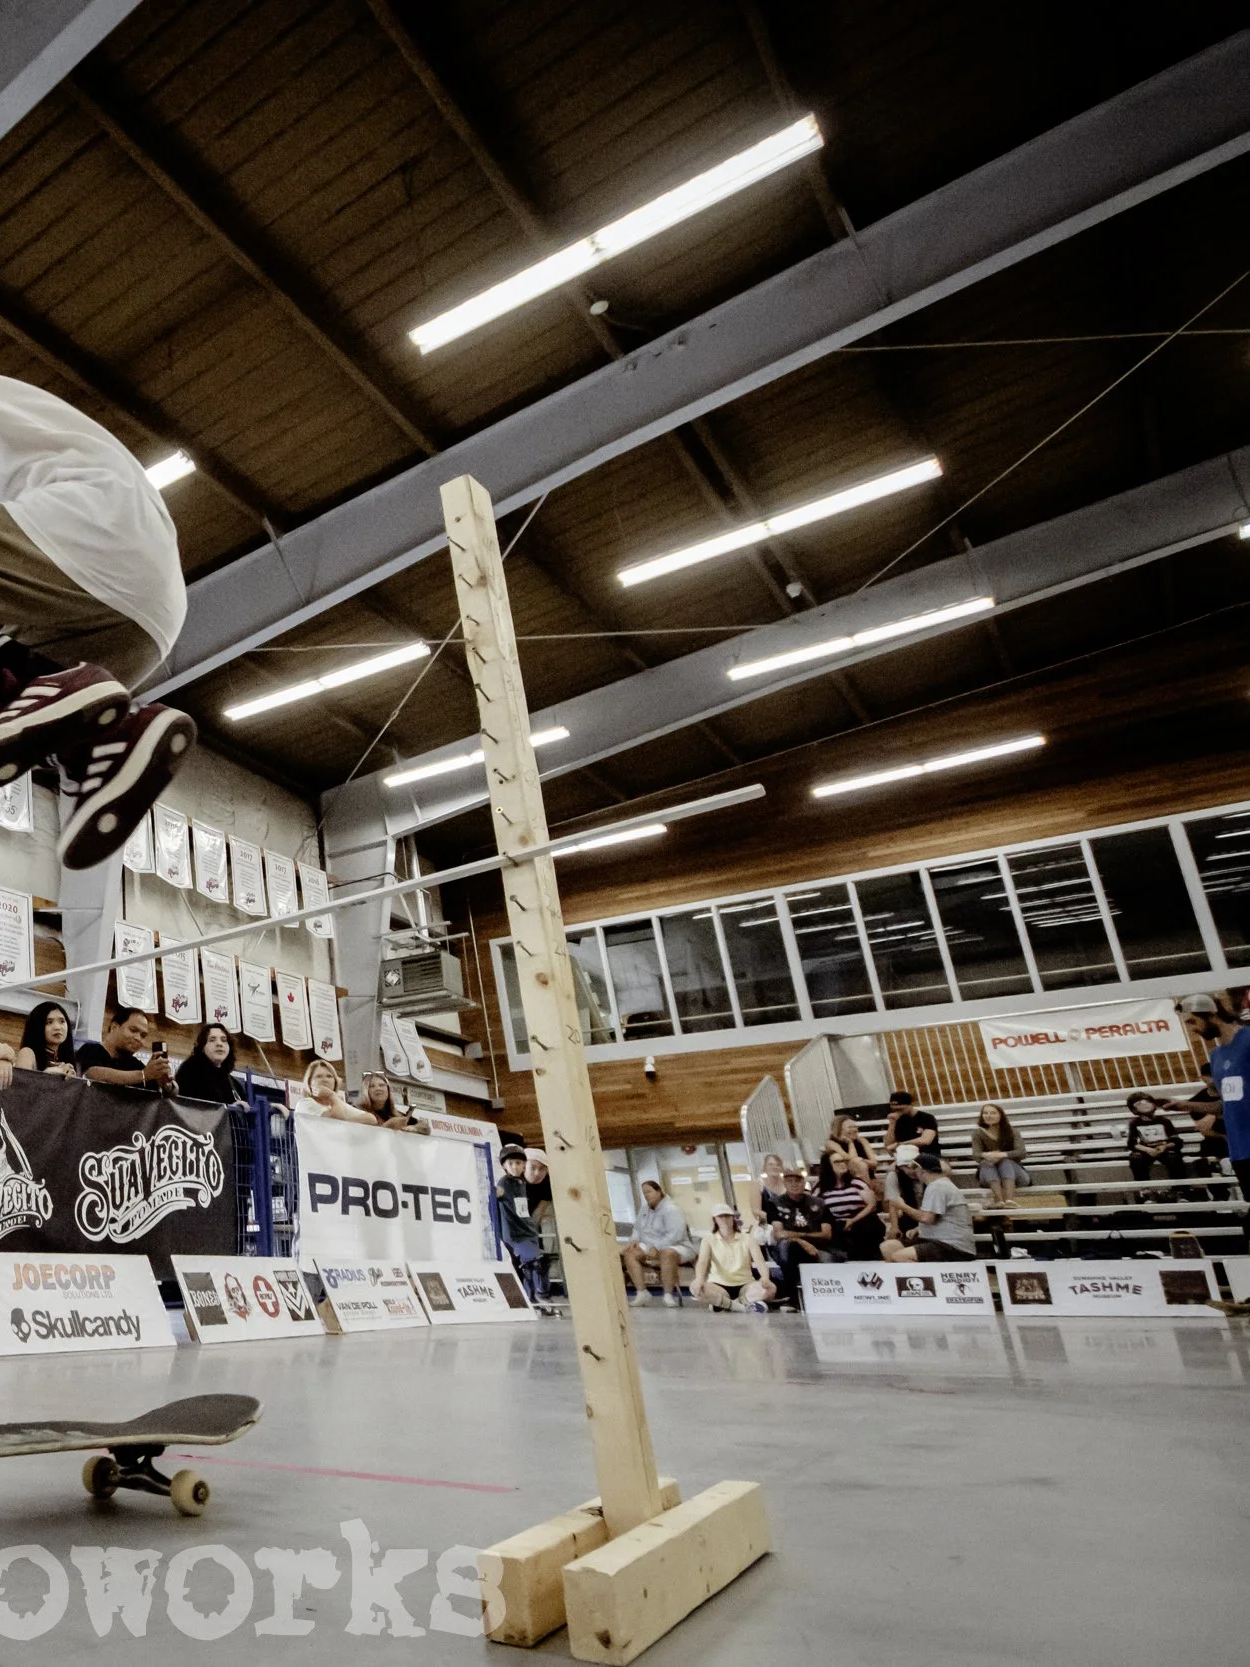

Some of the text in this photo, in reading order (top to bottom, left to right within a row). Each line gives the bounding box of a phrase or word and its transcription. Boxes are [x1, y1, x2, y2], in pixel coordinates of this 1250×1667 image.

[566, 1024, 581, 1045] 20
[991, 1019, 1170, 1050] POWELL PERALTA
[74, 1124, 225, 1242] SUAVECITO
[129, 1187, 182, 1230] POMADE
[12, 1263, 116, 1291] JOECORP
[335, 1268, 367, 1282] RADIUS
[811, 1277, 842, 1287] Skate
[189, 1289, 222, 1308] BONES
[457, 1284, 495, 1299] TASHME
[812, 1285, 845, 1295] board
[1068, 1282, 1143, 1296] TASHME
[31, 1308, 141, 1342] Skullcandy
